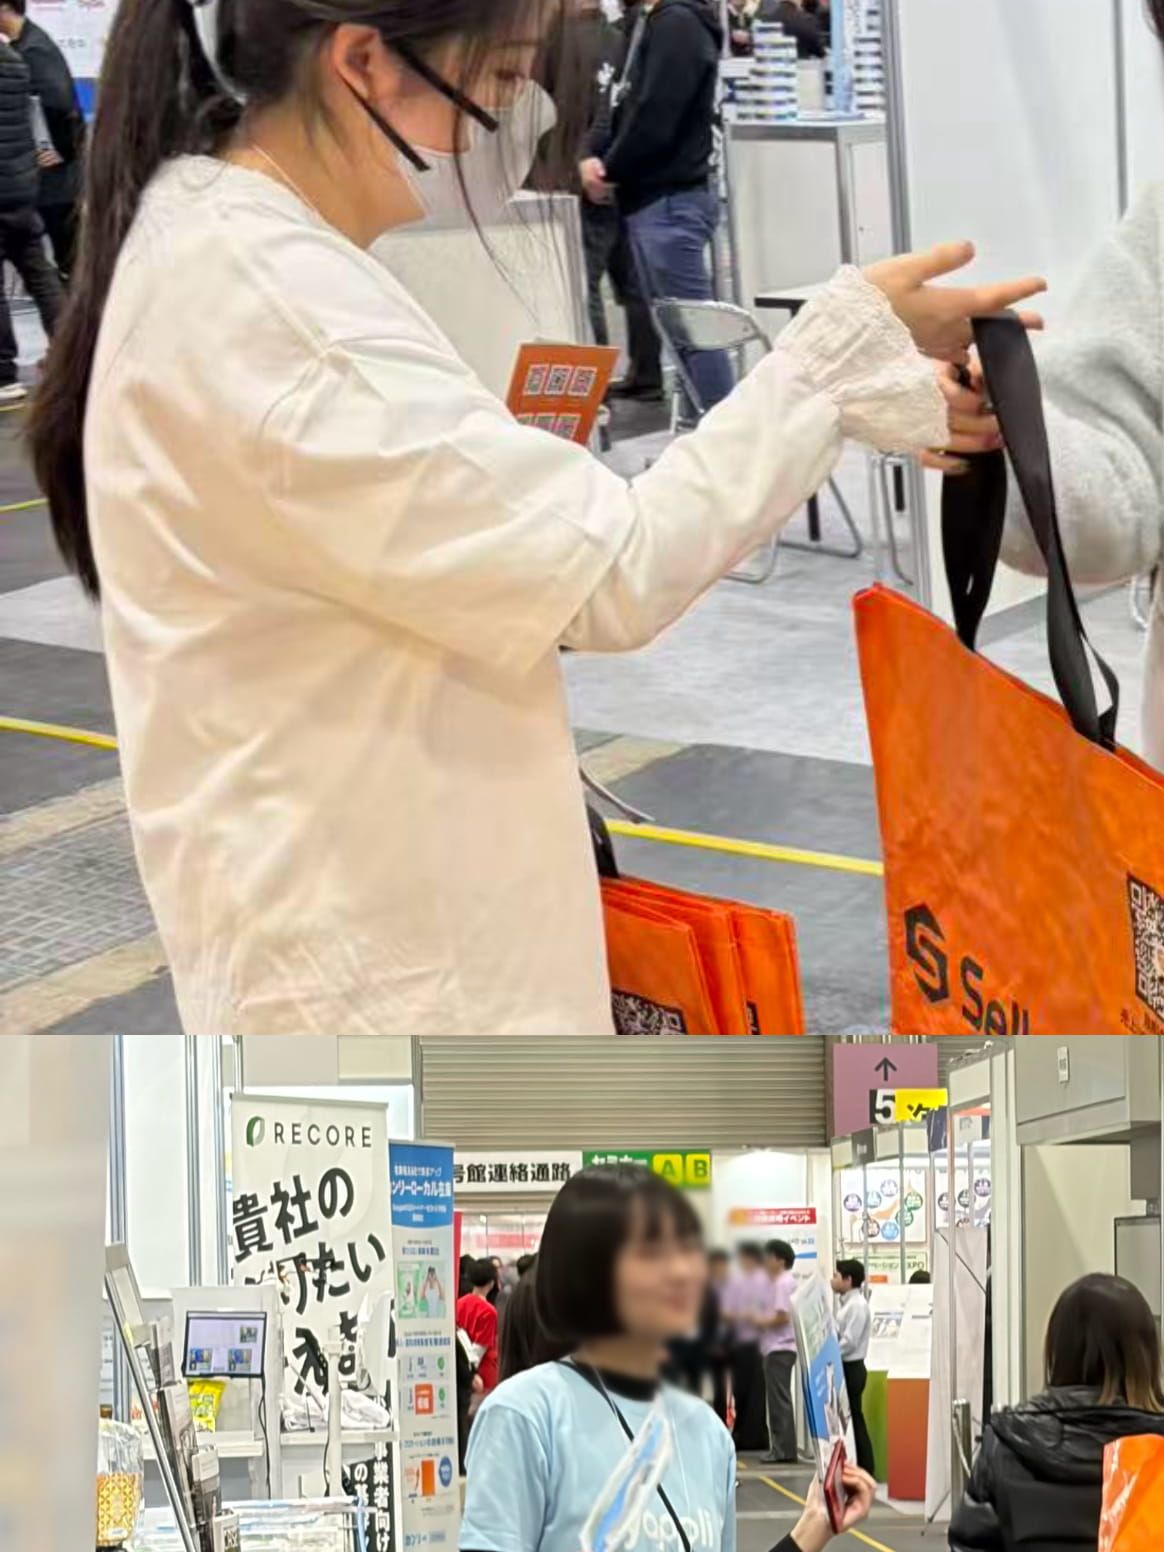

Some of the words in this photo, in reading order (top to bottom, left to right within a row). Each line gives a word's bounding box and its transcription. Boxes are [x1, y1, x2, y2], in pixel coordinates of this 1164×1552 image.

[274, 1122, 372, 1148] RECORE
[232, 1167, 355, 1263] 貴社の
